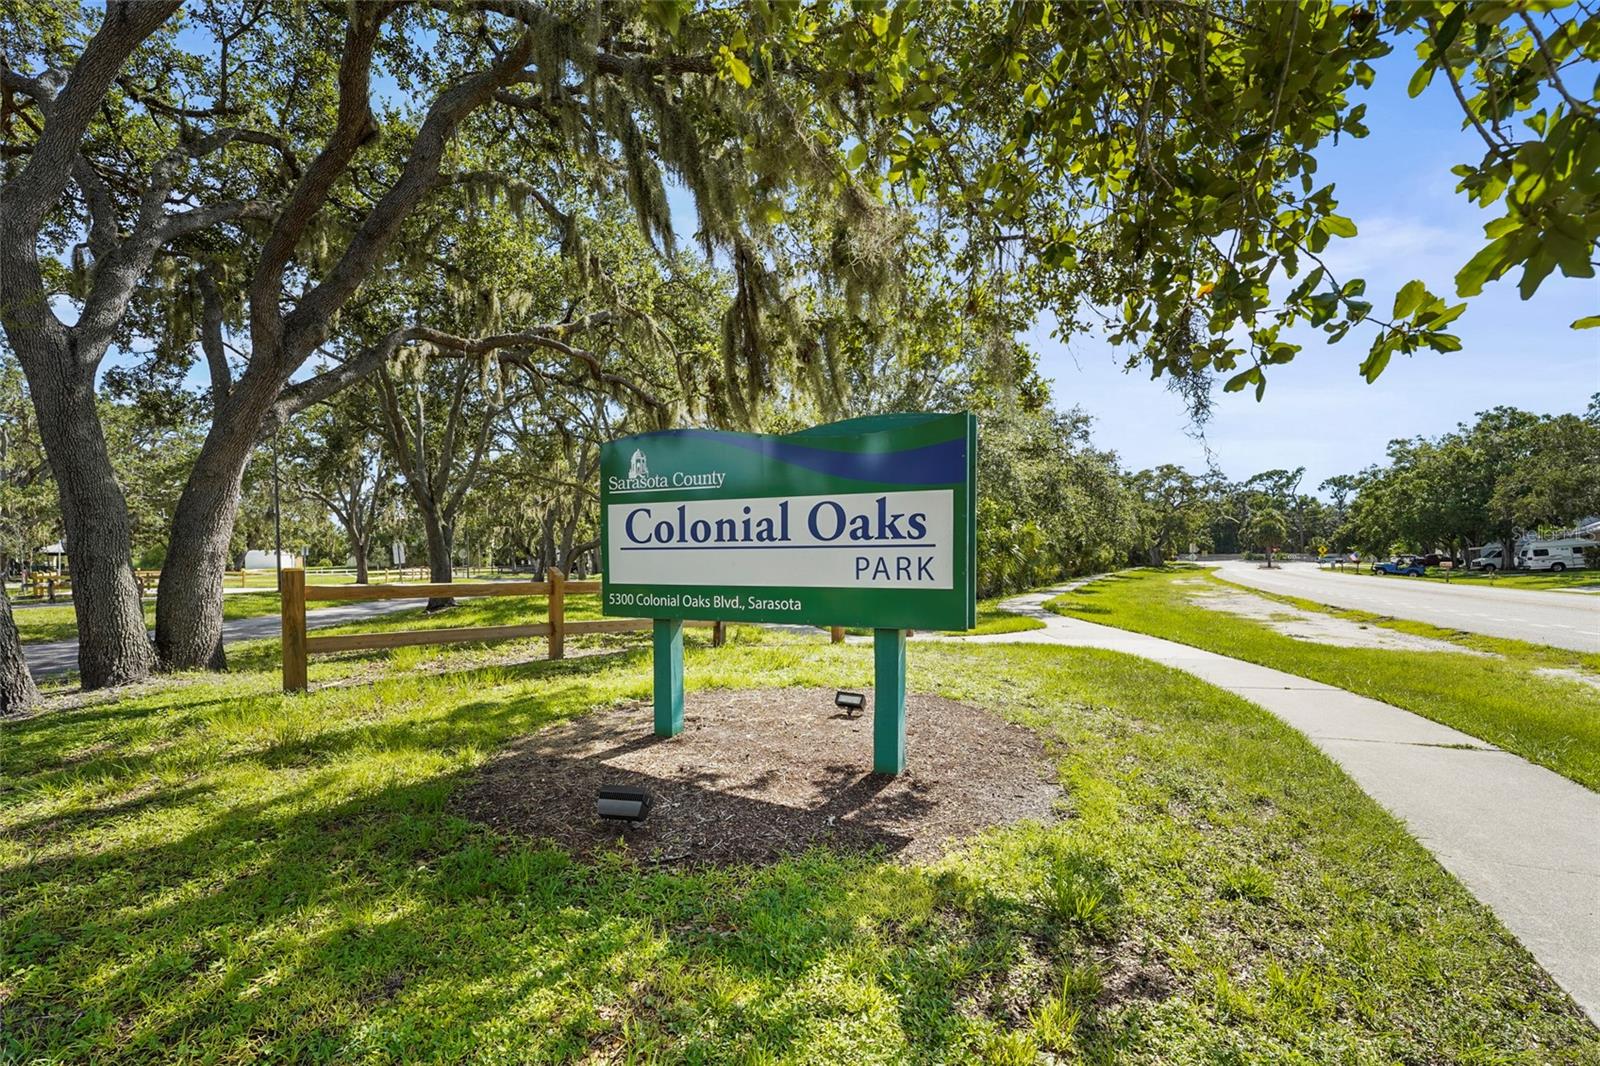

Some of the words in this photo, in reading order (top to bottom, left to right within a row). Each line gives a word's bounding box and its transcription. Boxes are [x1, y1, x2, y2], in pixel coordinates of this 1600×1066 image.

[609, 475, 668, 491] Sarasota
[673, 470, 726, 489] County
[625, 500, 791, 544] Colonial
[807, 496, 927, 541] Oaks
[855, 556, 935, 581] PARK
[609, 593, 634, 606] 5300
[636, 593, 680, 608] Colonial
[682, 594, 711, 609] Oaks
[713, 595, 746, 611] Blvd.,
[748, 596, 802, 612] Sarasota
